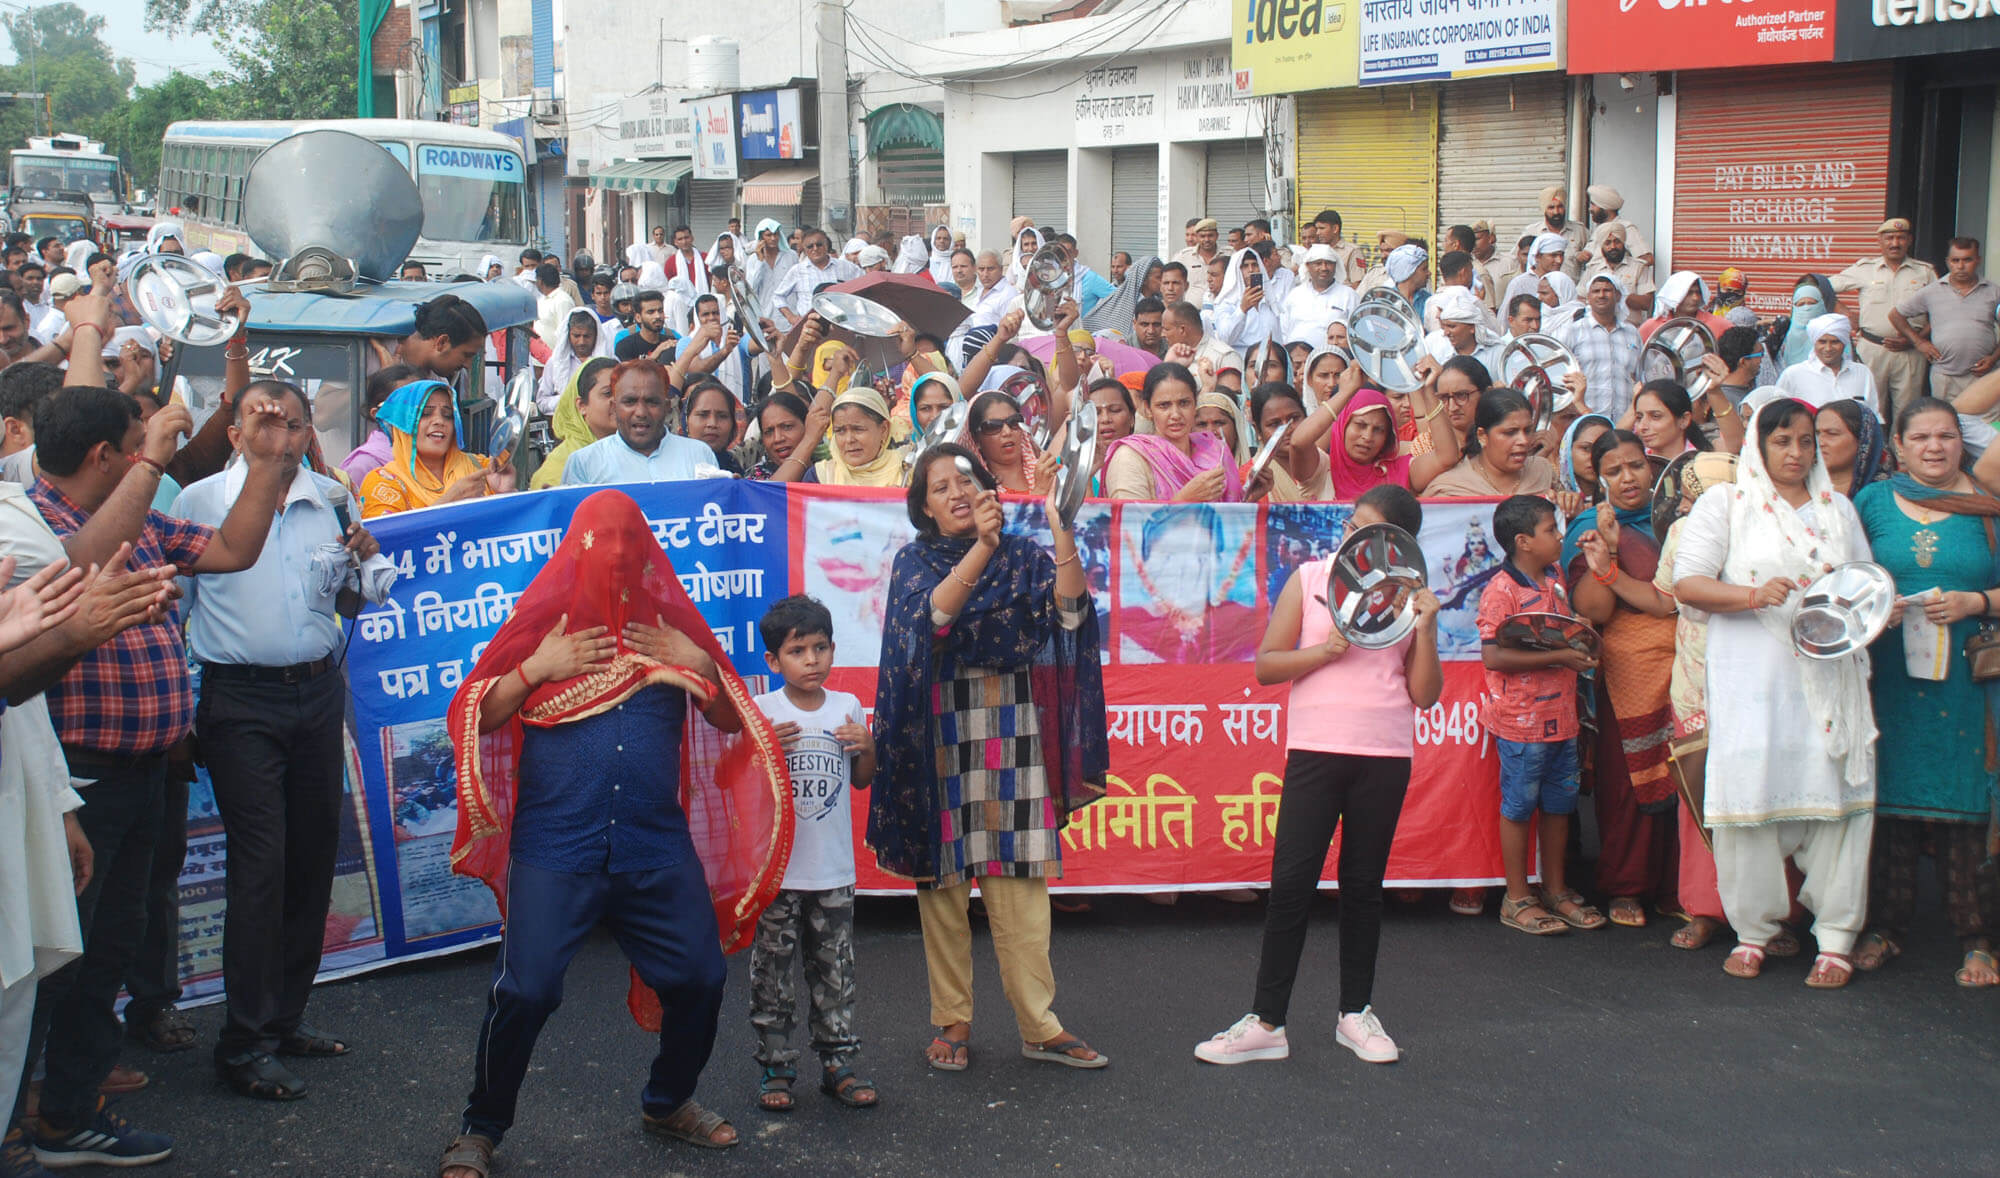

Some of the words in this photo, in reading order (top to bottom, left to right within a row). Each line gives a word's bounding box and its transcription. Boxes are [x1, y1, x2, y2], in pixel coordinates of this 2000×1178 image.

[1735, 11, 1786, 27] Authorized
[1788, 9, 1825, 23] Partner
[1363, 34, 1379, 52] LIFE
[1381, 27, 1430, 50] INSURANCE
[1432, 20, 1502, 45] CORPORATION
[1505, 17, 1519, 37] OF
[1522, 13, 1551, 35] INDIA
[1206, 56, 1224, 78] DAWA
[1177, 85, 1200, 110] HAKIM
[707, 104, 728, 136] Amul
[426, 149, 513, 172] ROADWAYS
[1714, 165, 1747, 191] PAY
[1752, 163, 1806, 190] BILLS
[1810, 161, 1856, 189] AND
[1729, 198, 1837, 224] RECHARGE
[1729, 234, 1834, 259] INSTANTLY
[423, 530, 457, 574] में
[462, 527, 563, 569] भाजपा
[641, 509, 691, 550] स्ट
[695, 502, 767, 547] टीचर
[357, 597, 406, 643] को
[413, 582, 525, 636] नियमि
[378, 664, 429, 700] पत्र
[437, 658, 463, 690] व
[1218, 687, 1282, 746] संघ
[785, 753, 842, 777] REESTYLE
[791, 779, 828, 798] SK8
[1058, 772, 1198, 851] समिति
